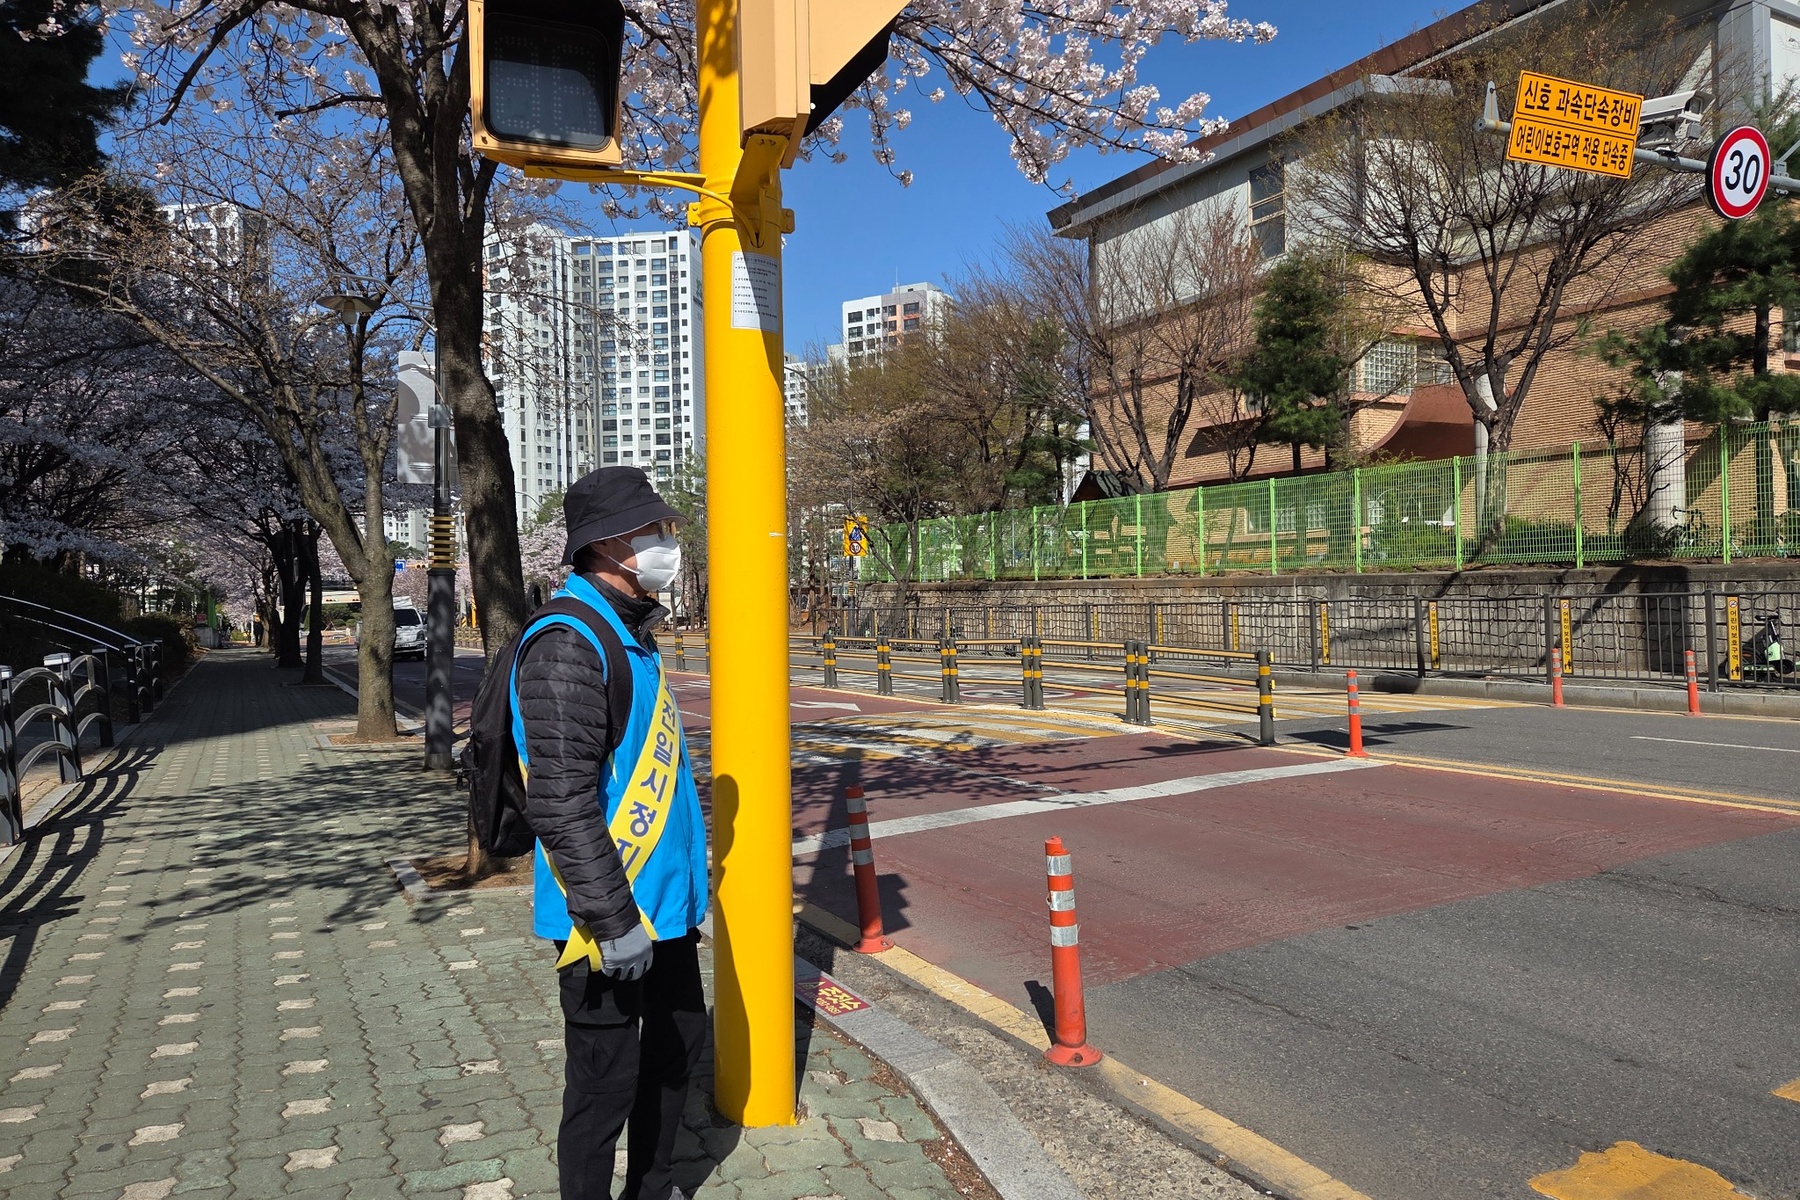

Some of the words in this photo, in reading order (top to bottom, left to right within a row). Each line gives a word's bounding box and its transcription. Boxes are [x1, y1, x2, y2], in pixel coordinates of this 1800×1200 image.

[1524, 80, 1551, 112] 신호
[1555, 88, 1637, 130] 과속단속장비
[1516, 125, 1578, 161] 어린이보호구역
[1582, 142, 1600, 167] 적용
[1602, 145, 1629, 172] 단속중
[1725, 149, 1760, 195] 30
[1730, 610, 1739, 661] 어린이보호구역
